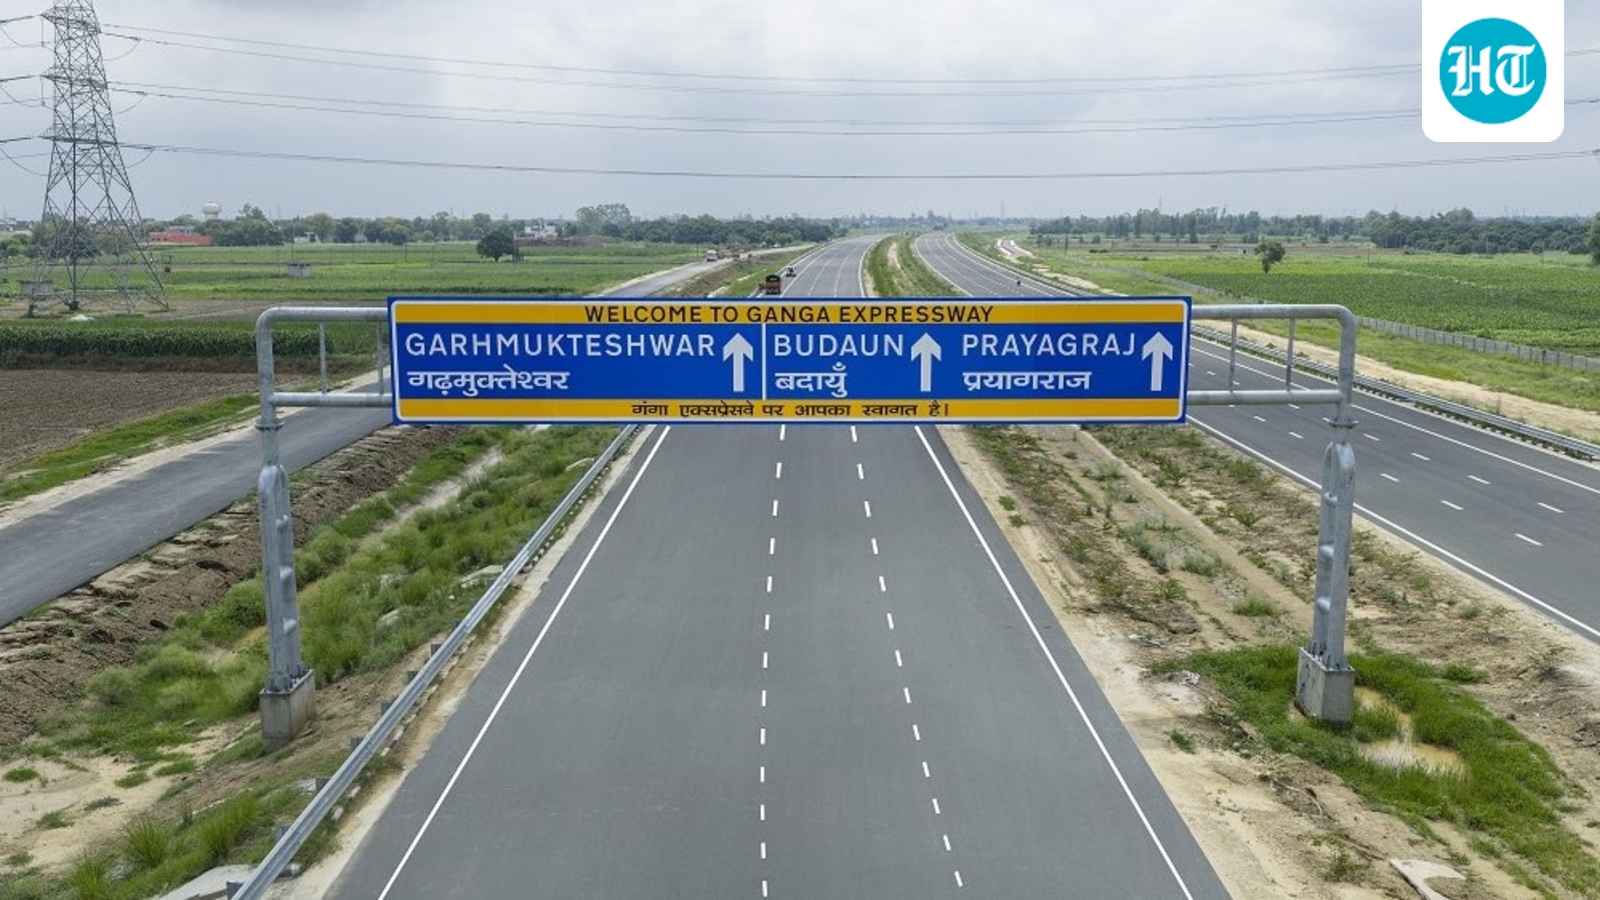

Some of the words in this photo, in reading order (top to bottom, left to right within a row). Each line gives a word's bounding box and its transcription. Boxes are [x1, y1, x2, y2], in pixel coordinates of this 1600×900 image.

[585, 306, 702, 322] WELCOME
[710, 306, 738, 322] TO
[747, 306, 830, 322] GANGA
[839, 306, 993, 322] EXPRESSWAY
[405, 333, 715, 357] GARHMUKTESHWAR
[774, 334, 904, 357] BUDAUN
[962, 333, 1135, 357] PRAYAGRAJ
[407, 364, 570, 396] गढ़मुक्तेश्वर
[962, 371, 1092, 391] प्रयागराज
[632, 402, 668, 416] गंगा
[679, 401, 755, 418] एक्सप्रेसवे
[762, 405, 784, 416] पर
[795, 405, 851, 417] आपका
[862, 405, 918, 417] स्वागत
